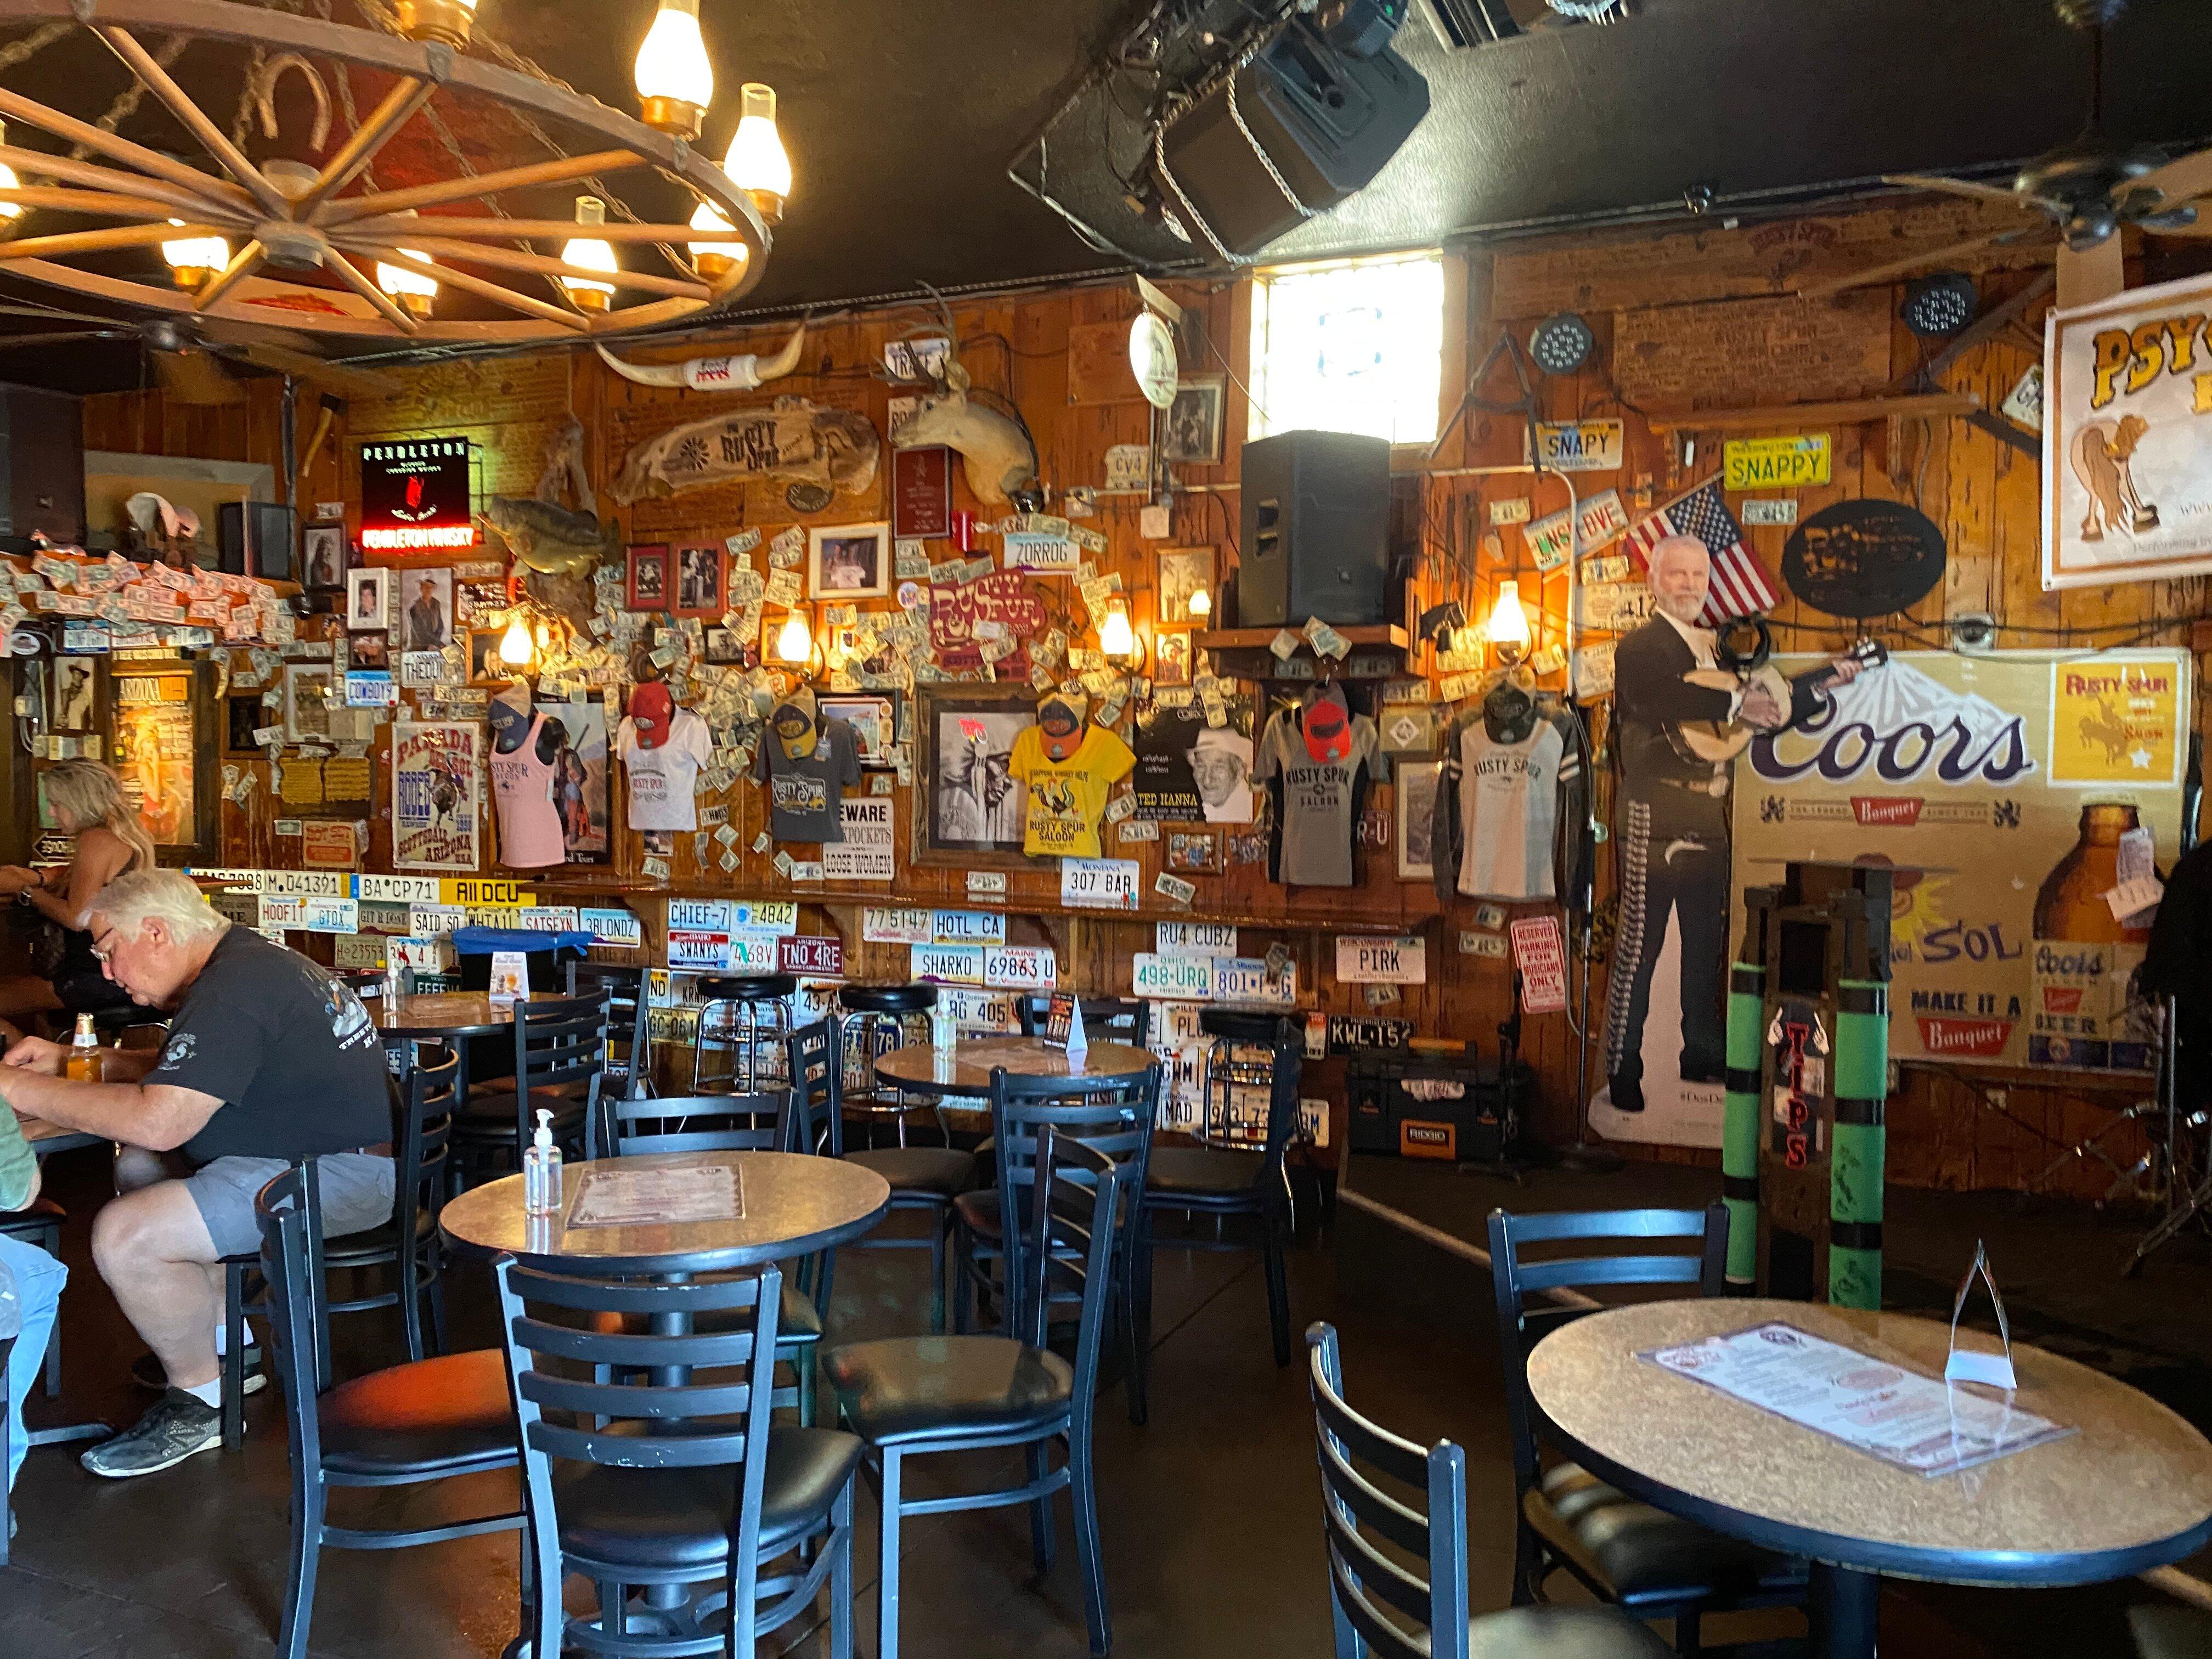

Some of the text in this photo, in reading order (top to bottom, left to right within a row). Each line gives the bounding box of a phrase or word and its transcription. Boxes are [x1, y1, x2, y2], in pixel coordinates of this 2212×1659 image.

[2091, 313, 2212, 410] PSY
[363, 441, 465, 461] PENDLETON
[1548, 433, 1609, 457] SNAPY
[1732, 454, 1821, 483] SNAPPY
[1751, 693, 2034, 781] Coors
[1286, 768, 1321, 786] RUSTY
[772, 778, 795, 803] RUSTY
[1137, 793, 1198, 807] TED HANNA
[839, 804, 887, 822] EWARE
[1861, 800, 1915, 822] Banquet
[1030, 821, 1086, 833] RUSTY SPUR
[1039, 830, 1075, 842] SALOON
[826, 854, 891, 874] LOOSE WOMEN
[364, 880, 434, 899] BA CP 71
[483, 883, 519, 902] DCU
[1071, 872, 1131, 894] 307 BAR
[262, 905, 303, 922] HOOFIT
[416, 913, 459, 932] SAID SO
[936, 915, 1000, 935] HOTL CA
[1160, 923, 1233, 946] RU4 CUBZ
[679, 941, 719, 959] SWANYS
[1520, 939, 1556, 953] PARKING
[1923, 919, 2023, 964] SOL
[923, 955, 972, 975] SHARKO
[989, 957, 1053, 978] 69863 U
[1359, 949, 1400, 972] PIRK
[1530, 975, 1555, 988] ONLY
[978, 1003, 1006, 1023] 405
[1911, 991, 2022, 1018] MAKE IT A
[1929, 1021, 2002, 1049] Banquet
[1785, 1022, 1810, 1170] TIPS
